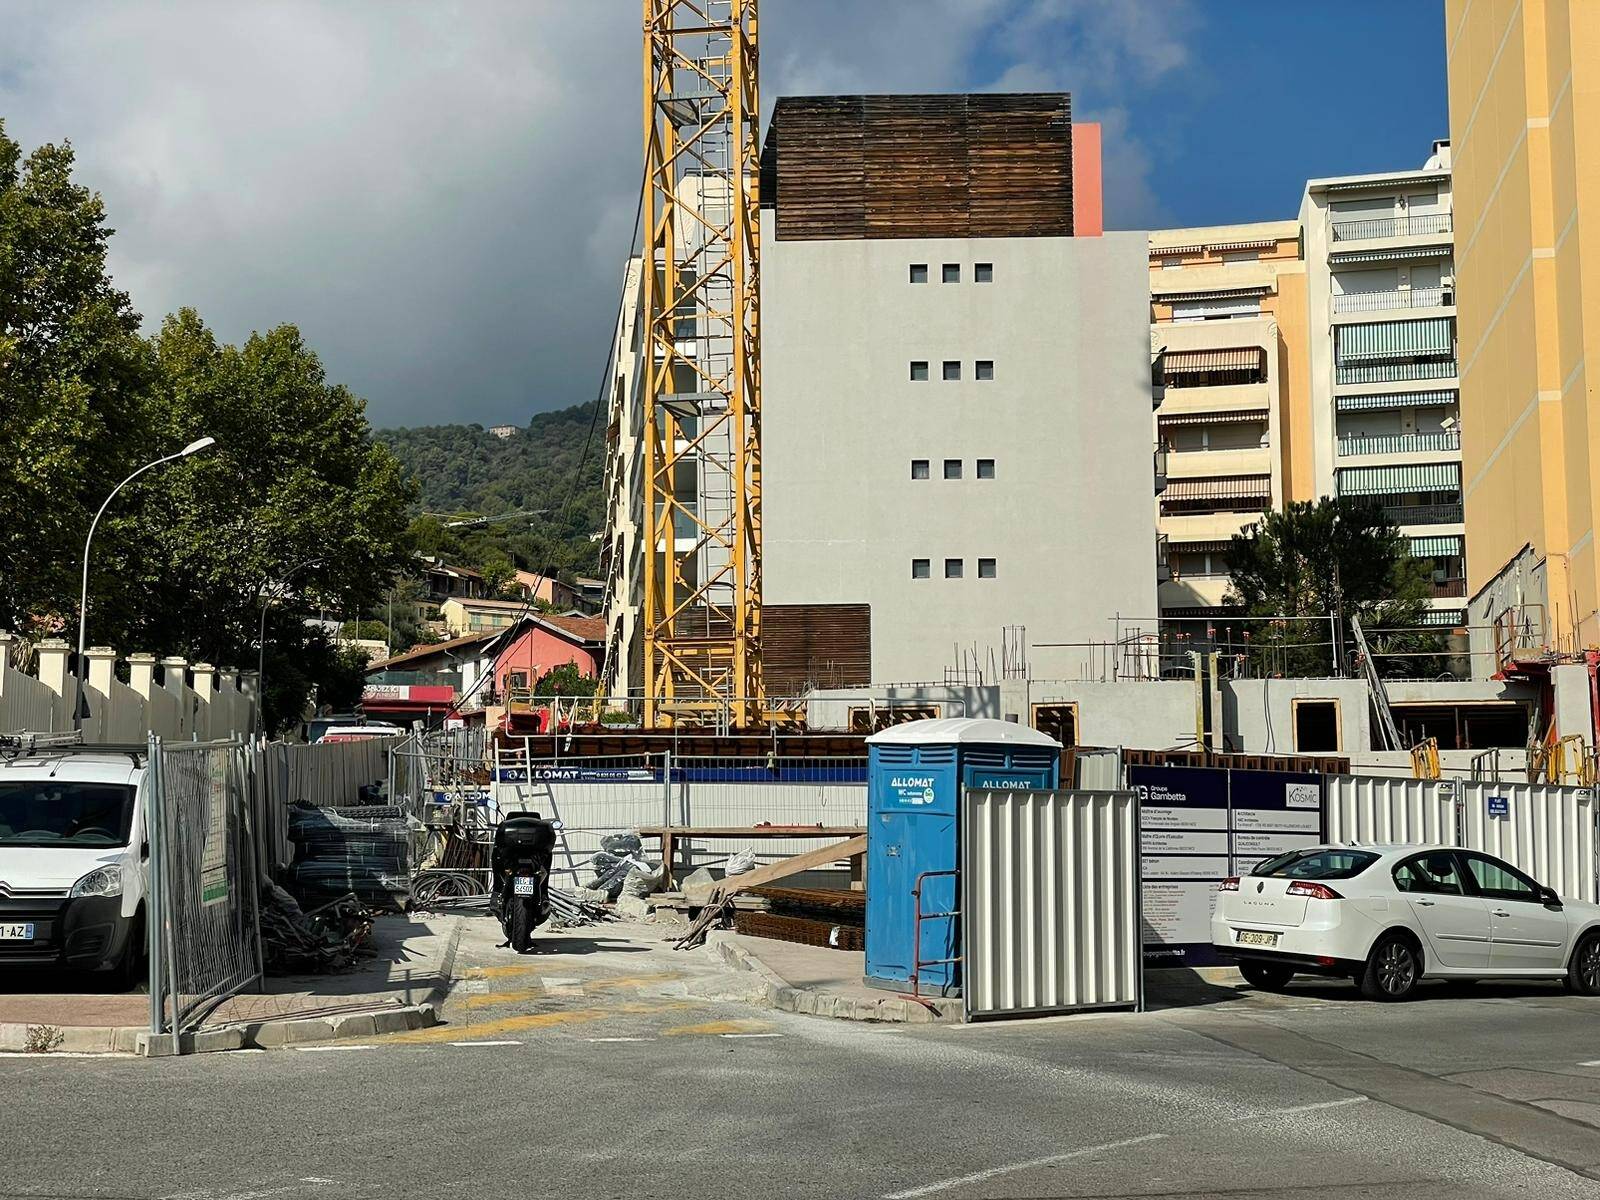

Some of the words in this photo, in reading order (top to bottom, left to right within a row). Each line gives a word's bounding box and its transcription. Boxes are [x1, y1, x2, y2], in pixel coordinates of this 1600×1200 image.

[519, 770, 579, 779] ALOMAT
[891, 777, 935, 787] ALLOMAT
[982, 780, 1031, 789] ALLOMAT
[1150, 791, 1187, 801] Gambetta
